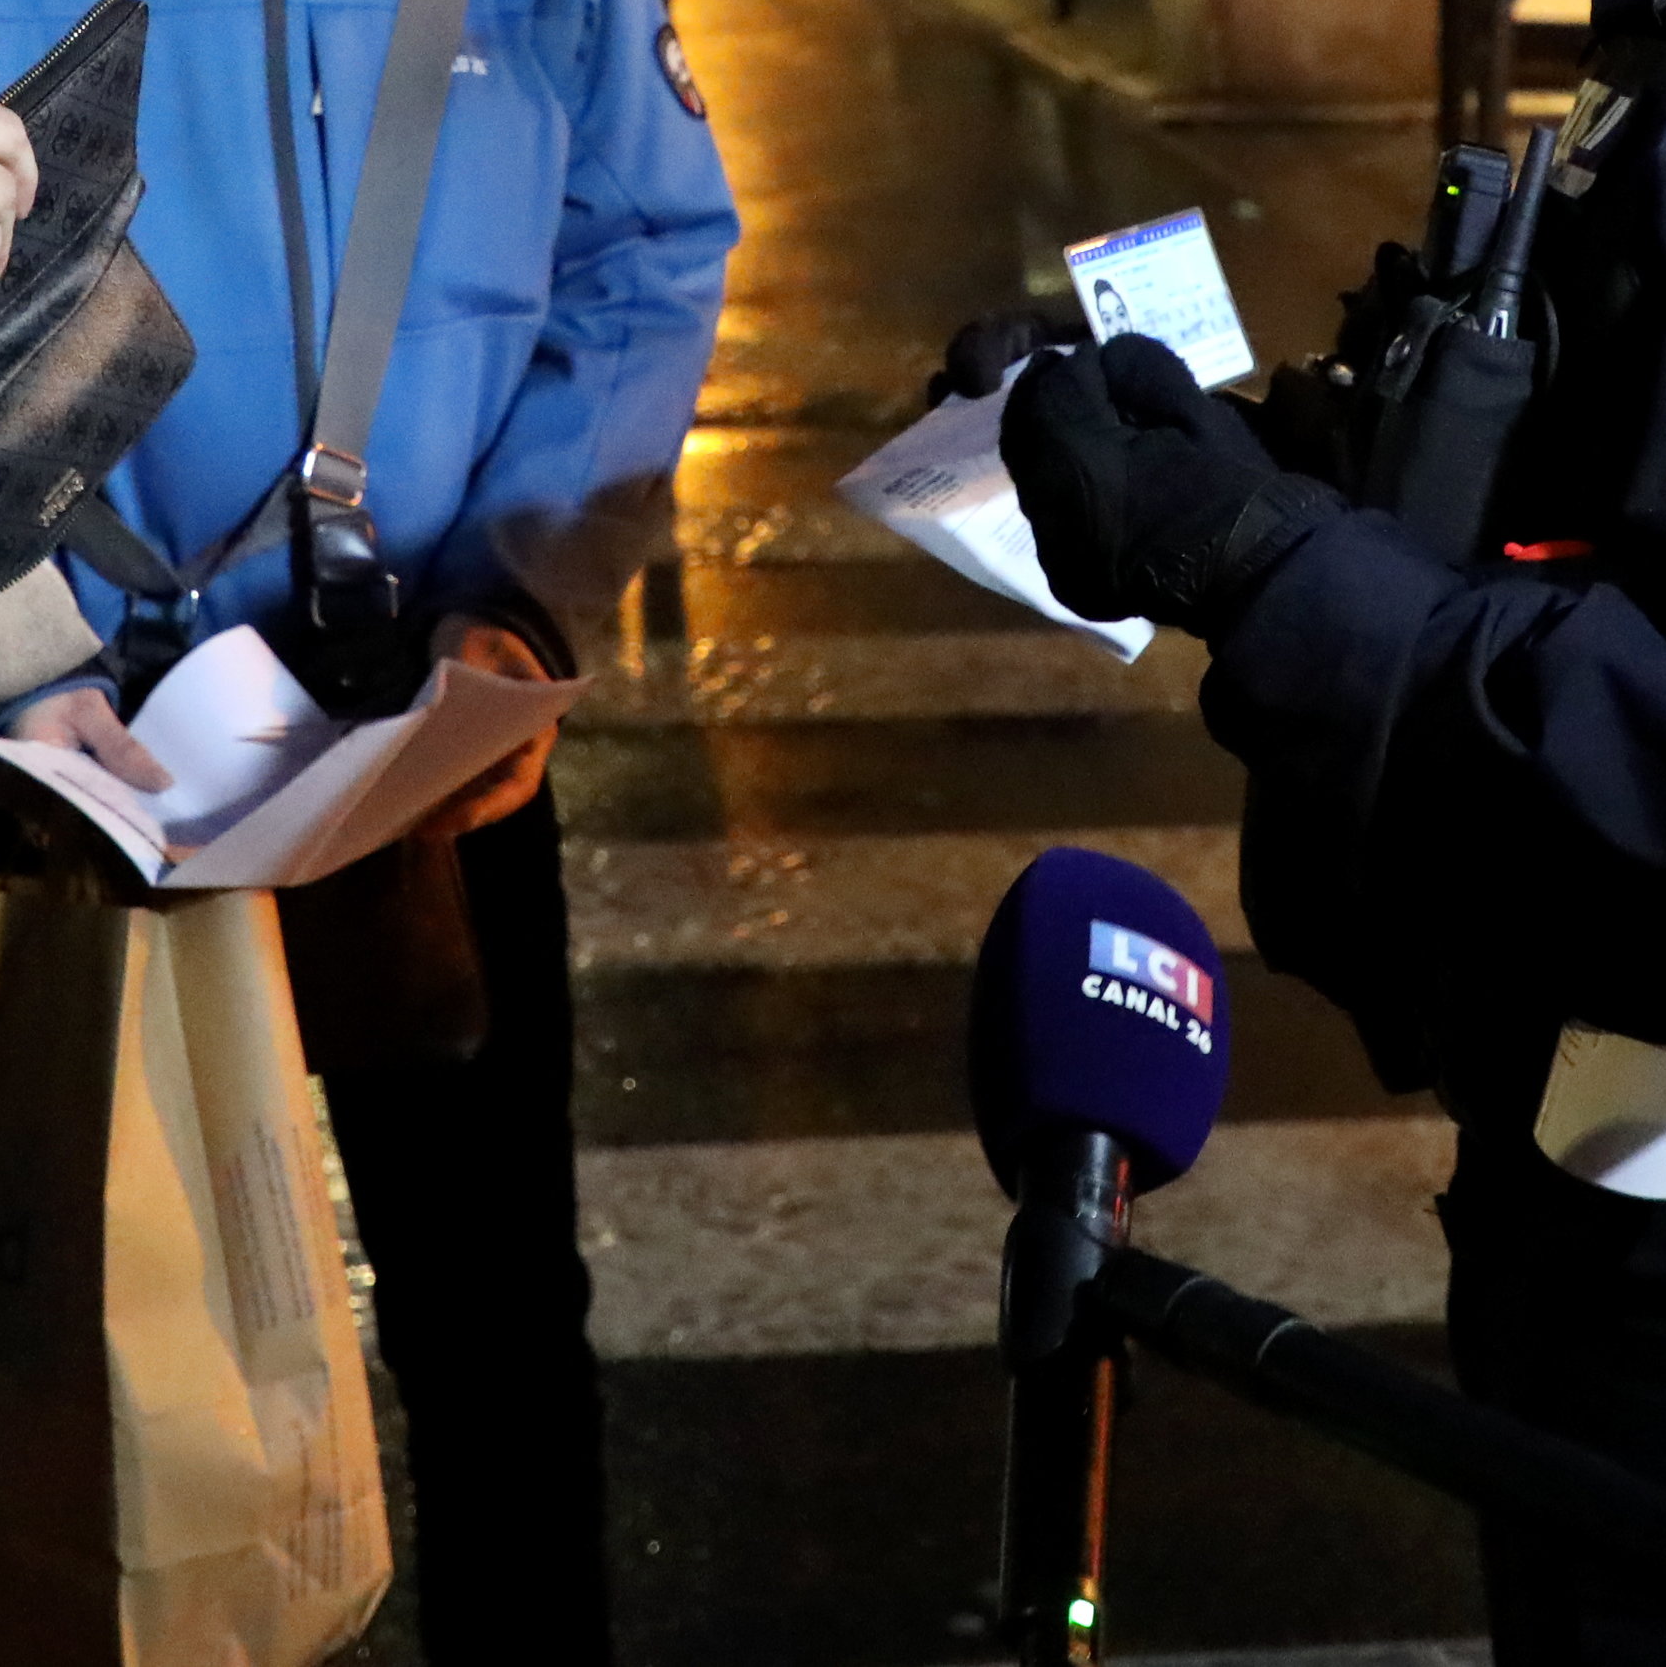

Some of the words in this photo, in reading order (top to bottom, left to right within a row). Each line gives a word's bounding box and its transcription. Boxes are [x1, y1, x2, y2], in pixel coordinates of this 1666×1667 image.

[1111, 929, 1200, 1009] LCI
[1080, 973, 1181, 1031] CANAL
[1185, 1018, 1212, 1055] 26
